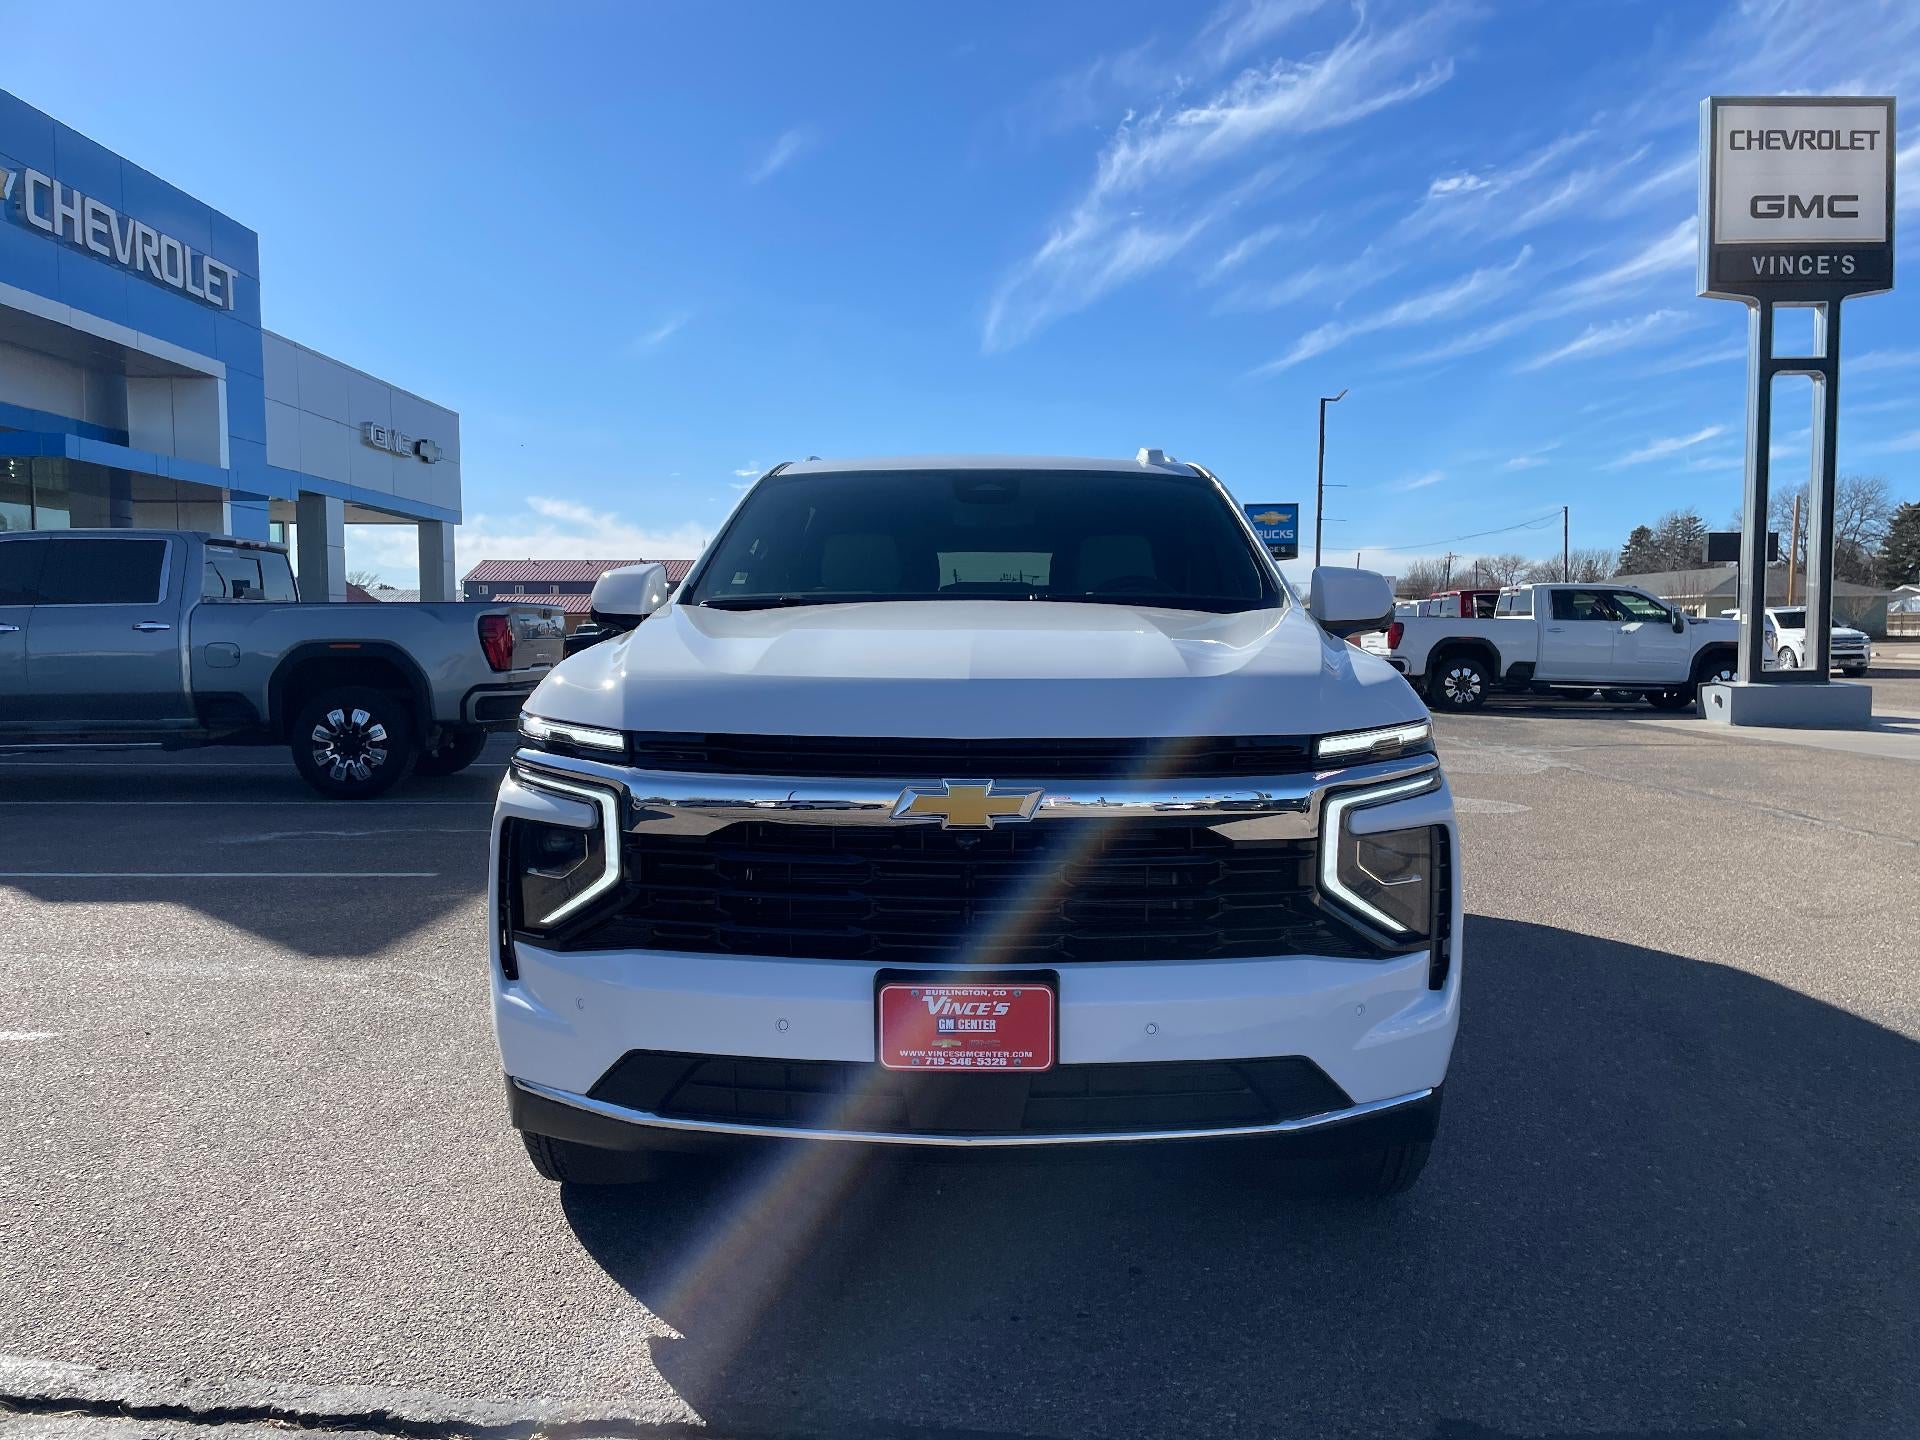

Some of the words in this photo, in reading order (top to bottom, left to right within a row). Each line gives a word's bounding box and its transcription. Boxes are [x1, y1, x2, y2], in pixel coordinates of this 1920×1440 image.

[1729, 130, 1881, 151] CHEVROLET
[1750, 195, 1859, 219] GMC
[24, 167, 239, 311] CHEVROLET
[1752, 255, 1856, 275] VINCE'S
[370, 422, 413, 458] GMC
[1258, 529, 1294, 539] RUCKS
[938, 1018, 955, 1030] GM
[957, 1018, 997, 1031] CENTER
[899, 1050, 1033, 1058] WWW.VINCESGMCENTER.COM
[925, 1057, 1007, 1066] 719-346-5326
